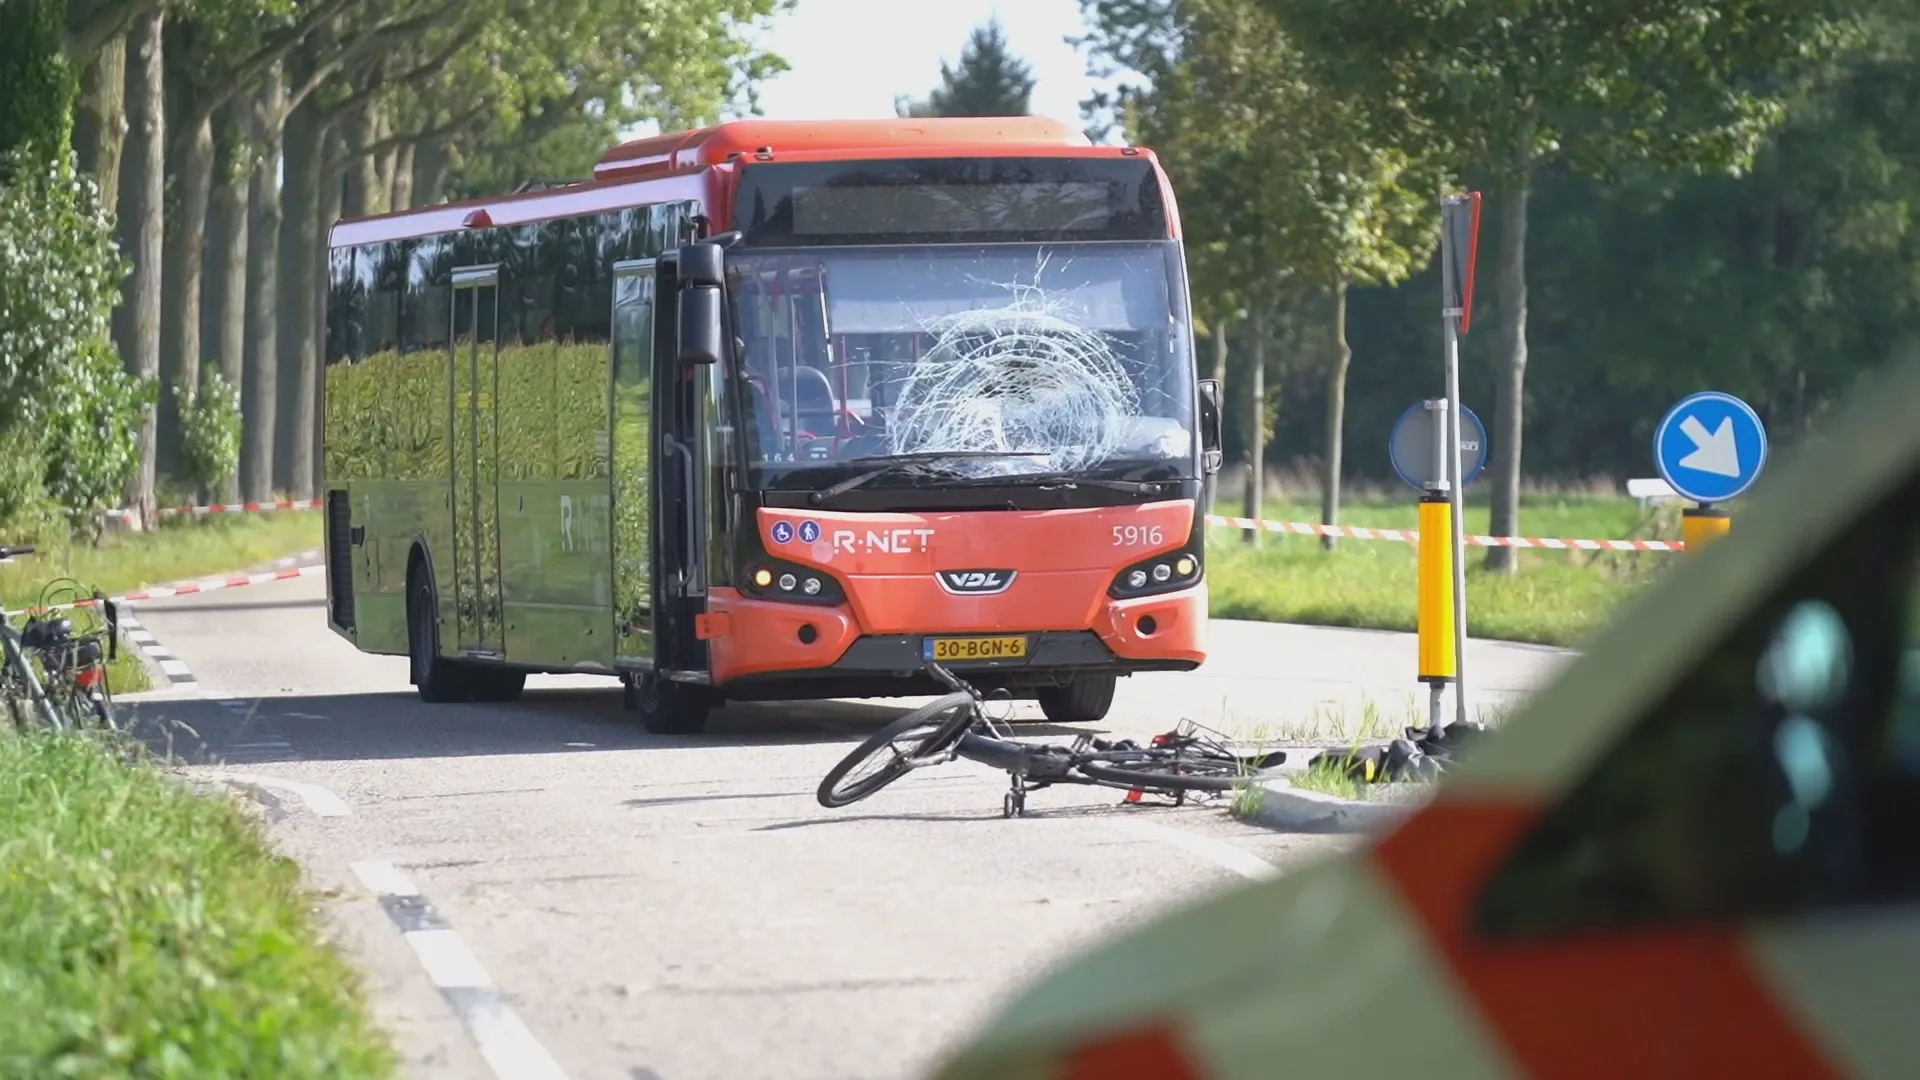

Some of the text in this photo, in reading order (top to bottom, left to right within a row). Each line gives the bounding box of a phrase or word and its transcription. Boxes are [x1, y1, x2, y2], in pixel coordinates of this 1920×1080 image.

[1112, 525, 1163, 546] 5916
[949, 572, 1001, 587] VDL
[937, 639, 1020, 657] 30-BGN-6
